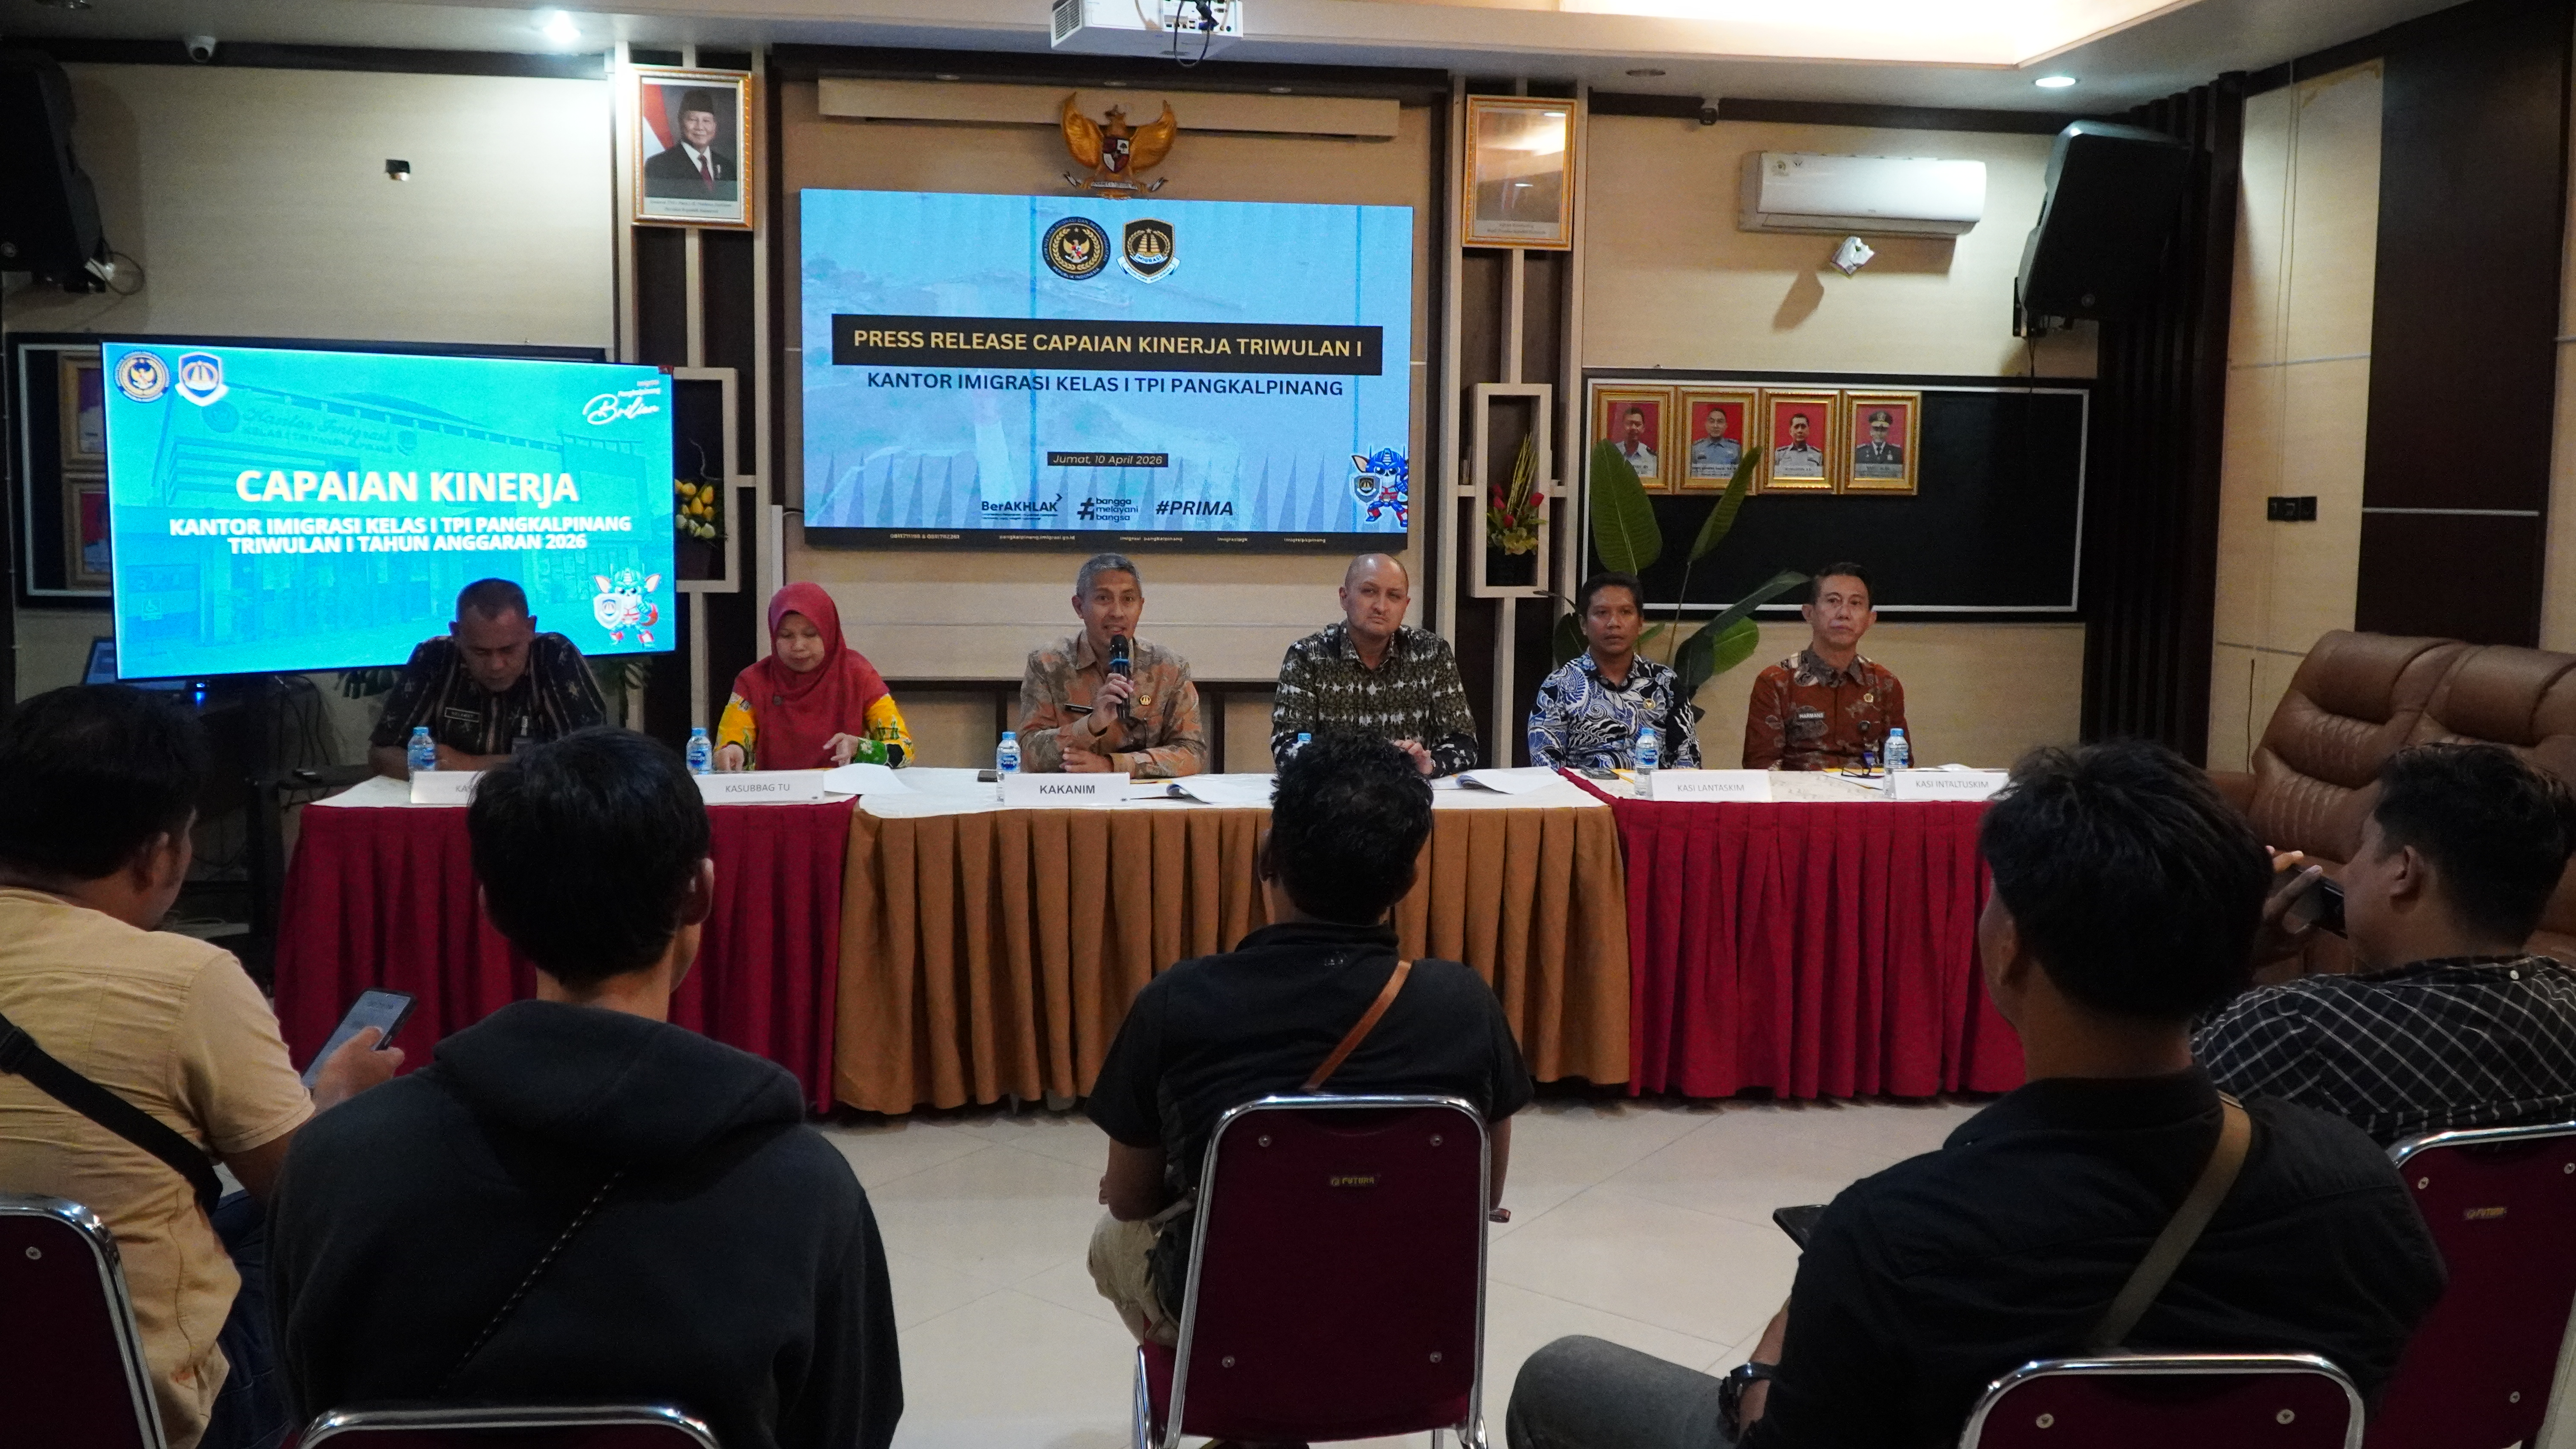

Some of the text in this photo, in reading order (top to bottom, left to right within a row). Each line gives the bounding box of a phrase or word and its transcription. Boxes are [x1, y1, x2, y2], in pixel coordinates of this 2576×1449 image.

[854, 330, 1361, 357] PRESS RELEASE CAPAIAN KINERJA TRIWULAN I
[868, 373, 1343, 395] KANTOR IMIGRASI KELAS I TPI PANGKALPINANG
[1053, 455, 1162, 466] Jumat, 10 April 2026
[236, 470, 579, 509] CAPAIAN KINERJA
[981, 501, 1058, 512] BerAKHLAK
[1096, 497, 1131, 506] bangga
[1155, 501, 1233, 515] #PRIMA
[1096, 514, 1130, 522] bangsa
[170, 516, 632, 536] KANTOR IMIGRASI KELAS I TPI PANGKALPINANG
[228, 534, 587, 554] TRIWULAN I TAHUN ANGGARAN 2026
[726, 784, 775, 792] KASUBBAG
[1040, 785, 1095, 794] KAKANIM
